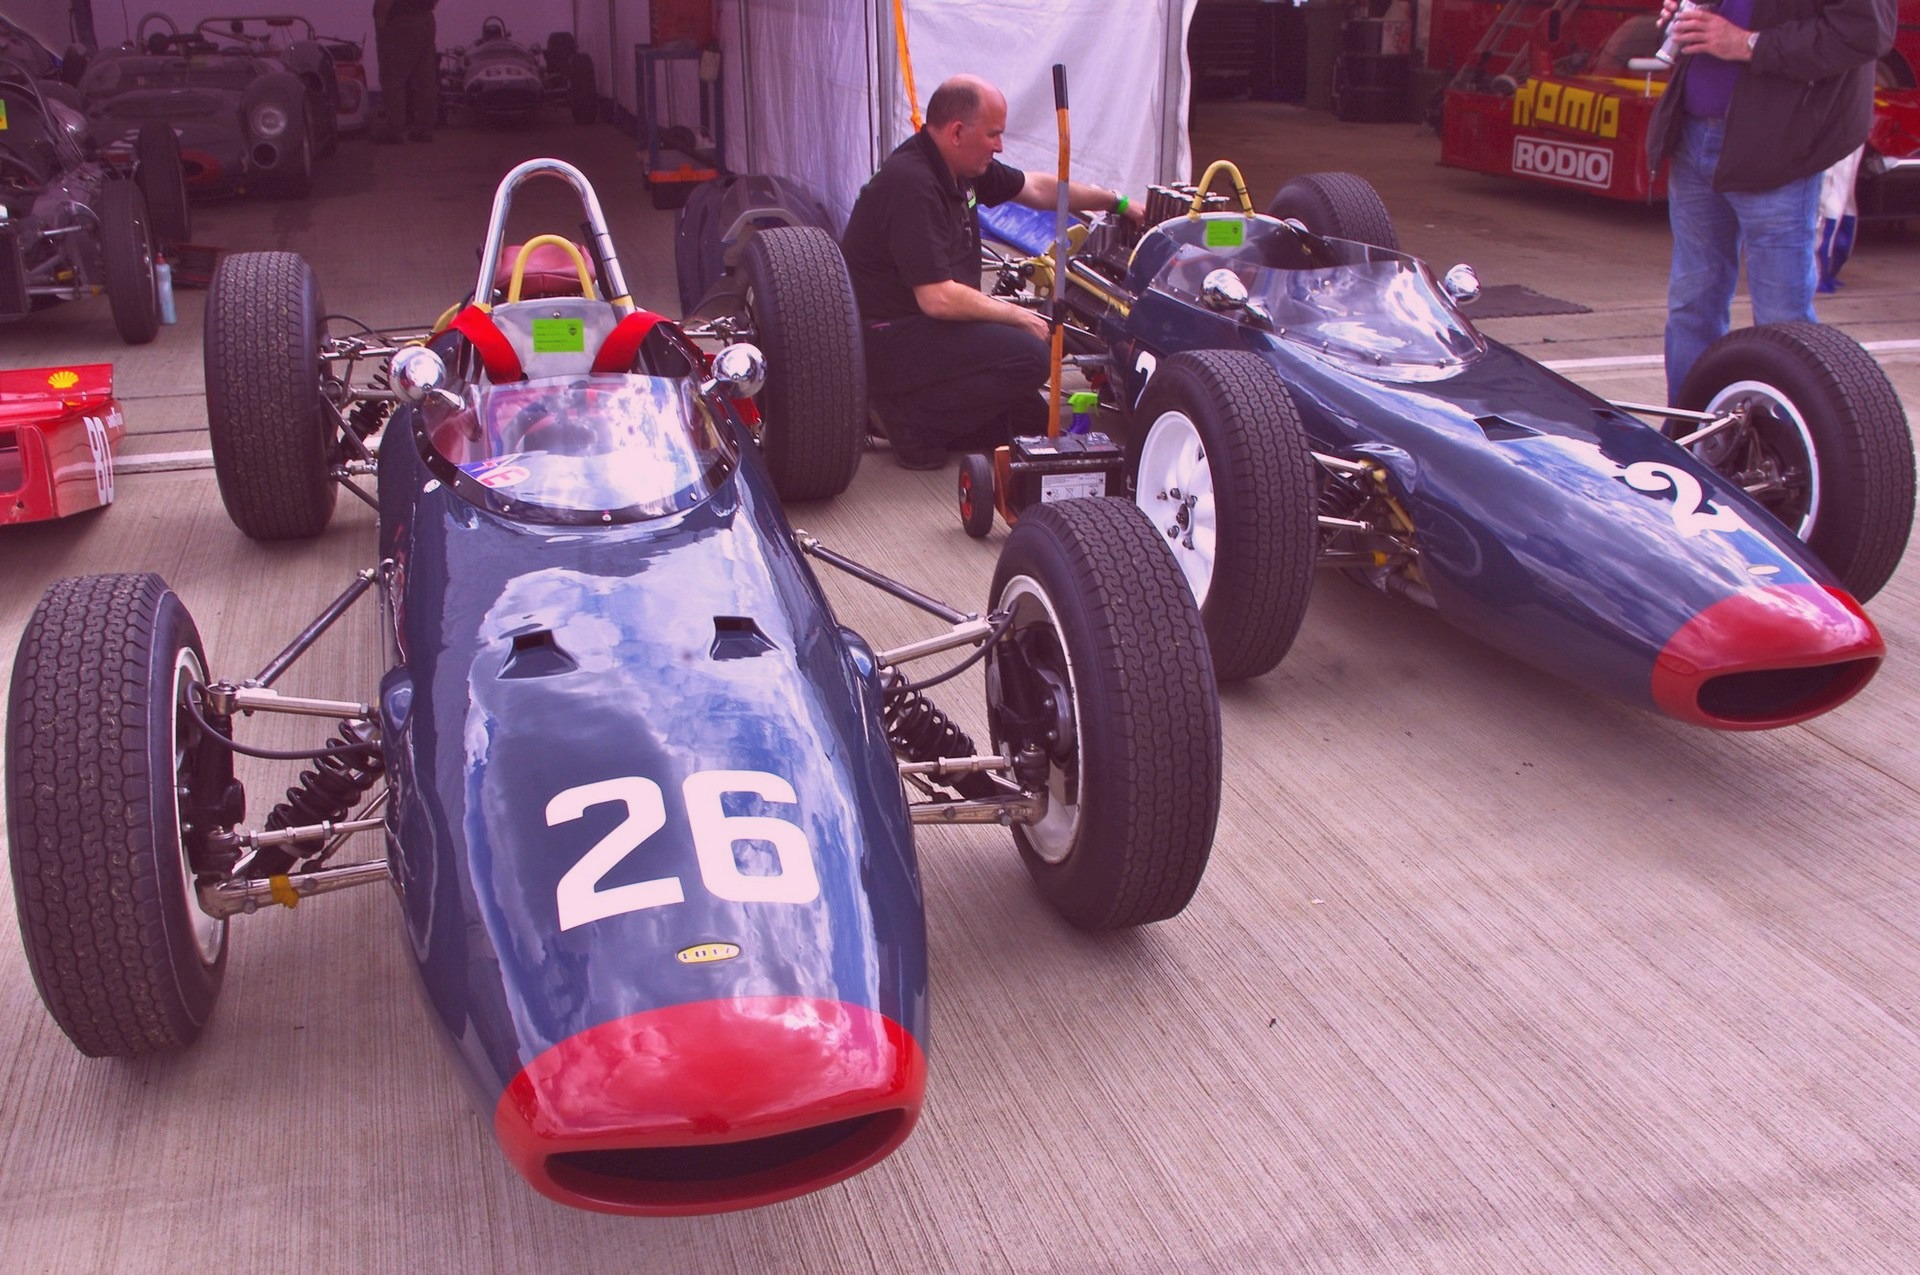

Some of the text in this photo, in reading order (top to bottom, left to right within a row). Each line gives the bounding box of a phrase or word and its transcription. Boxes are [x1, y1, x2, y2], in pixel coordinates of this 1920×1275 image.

[1515, 141, 1609, 182] RODIO
[83, 416, 115, 506] 80
[1624, 461, 1744, 538] 2
[545, 769, 820, 931] 26
